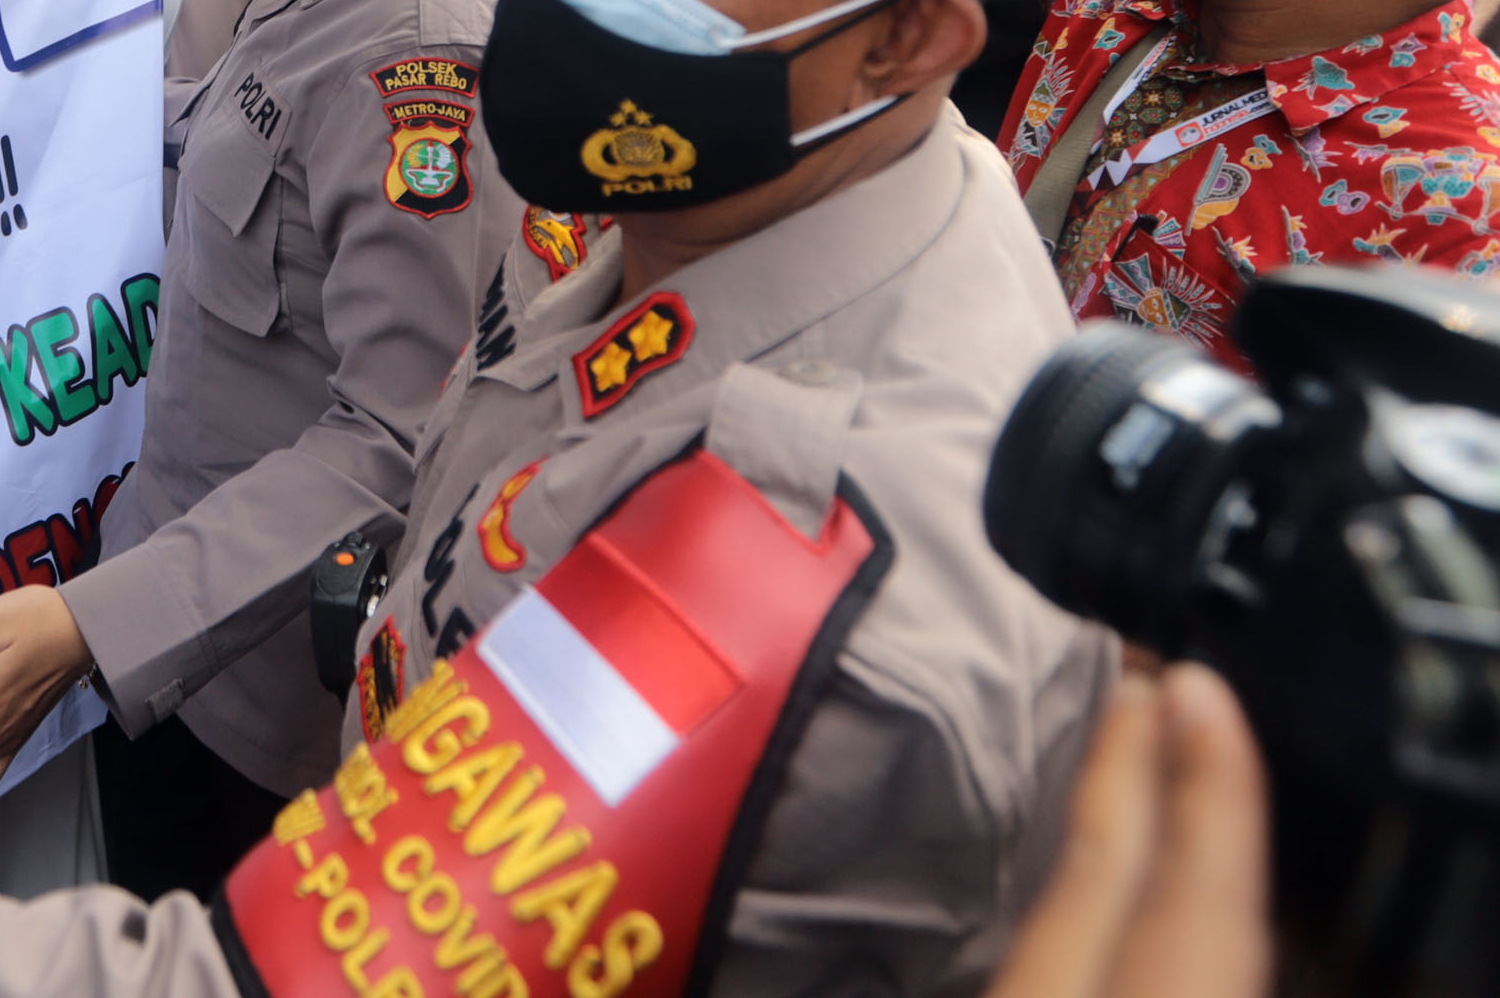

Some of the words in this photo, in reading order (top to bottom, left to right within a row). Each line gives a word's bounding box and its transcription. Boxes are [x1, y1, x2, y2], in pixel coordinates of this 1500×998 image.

[395, 60, 458, 77] POLSEK
[385, 73, 427, 91] PASAR
[434, 73, 468, 90] REBO
[234, 72, 282, 140] POLRI
[394, 103, 466, 121] METRO-JAYA
[601, 175, 693, 197] POLRI
